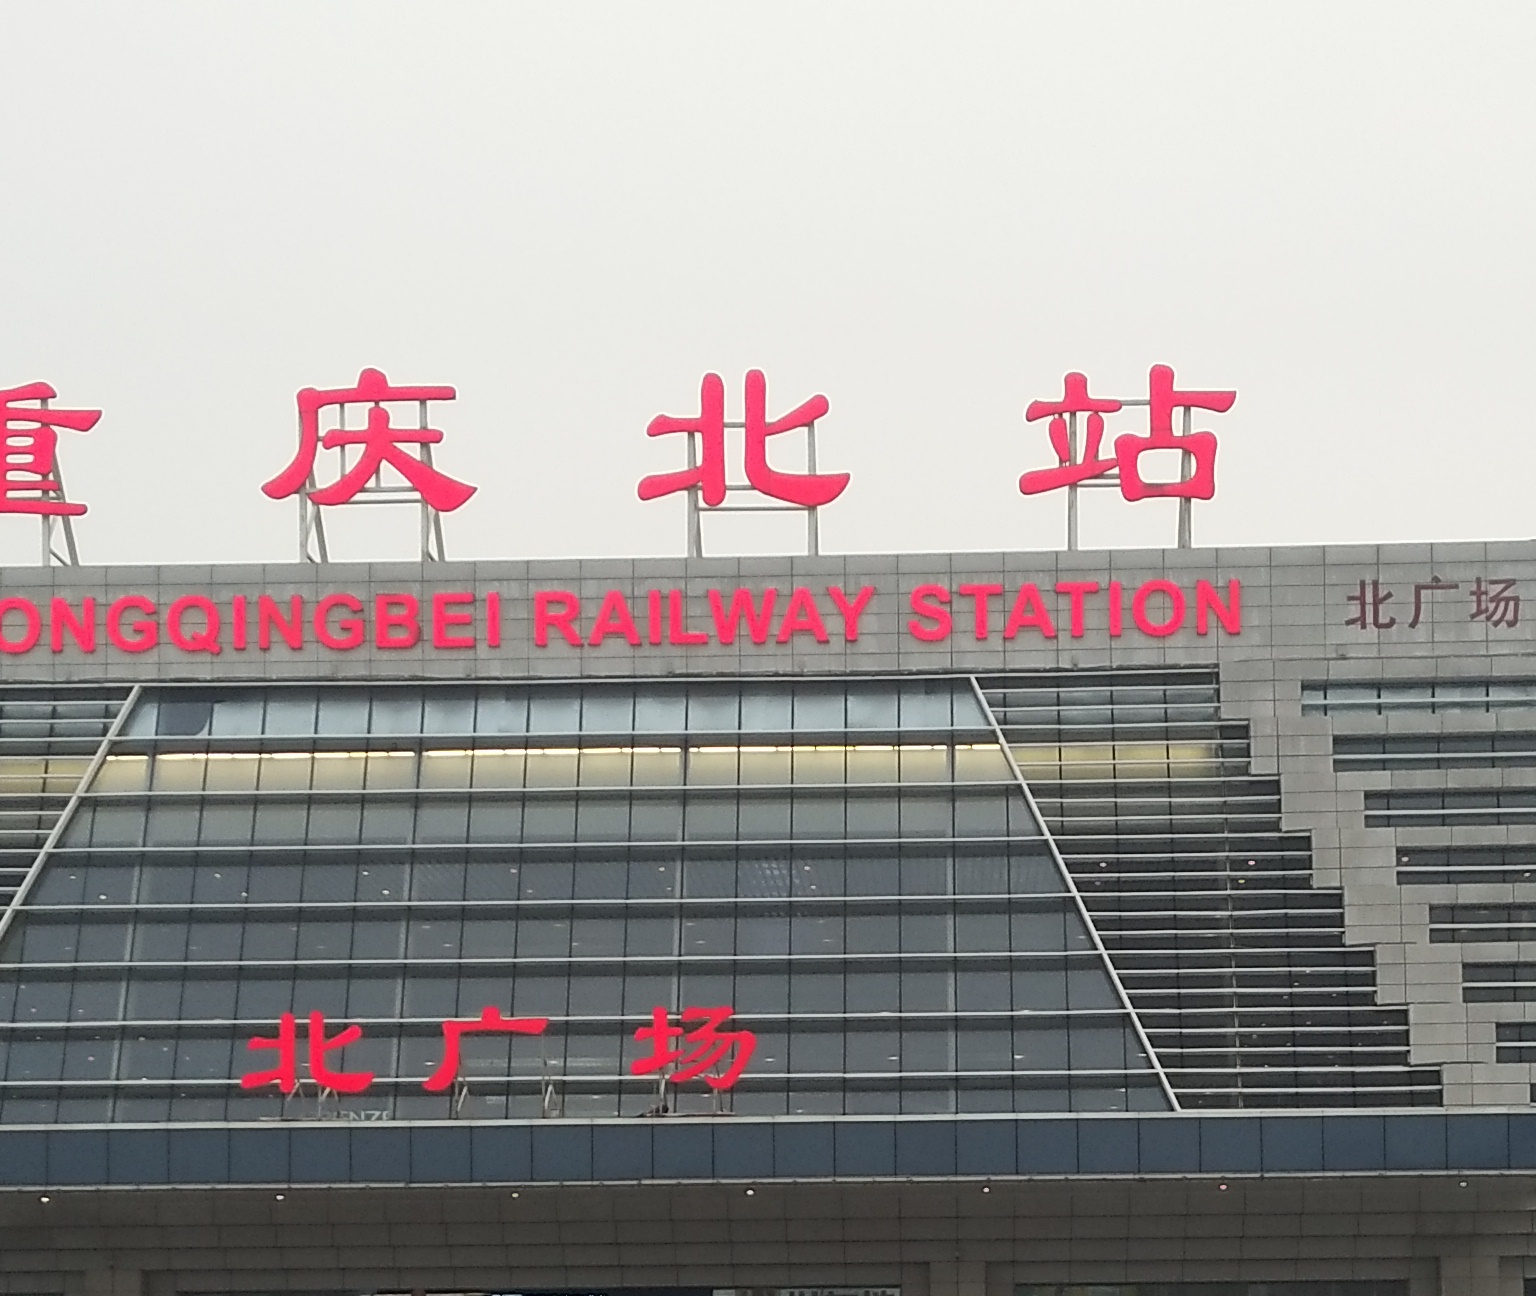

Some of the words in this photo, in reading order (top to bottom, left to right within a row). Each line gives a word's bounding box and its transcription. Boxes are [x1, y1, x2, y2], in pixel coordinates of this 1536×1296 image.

[533, 584, 875, 648] RAILWAY
[908, 578, 1242, 644] STATION
[1344, 575, 1521, 630] 北广场
[240, 1006, 757, 1093] 北广场
